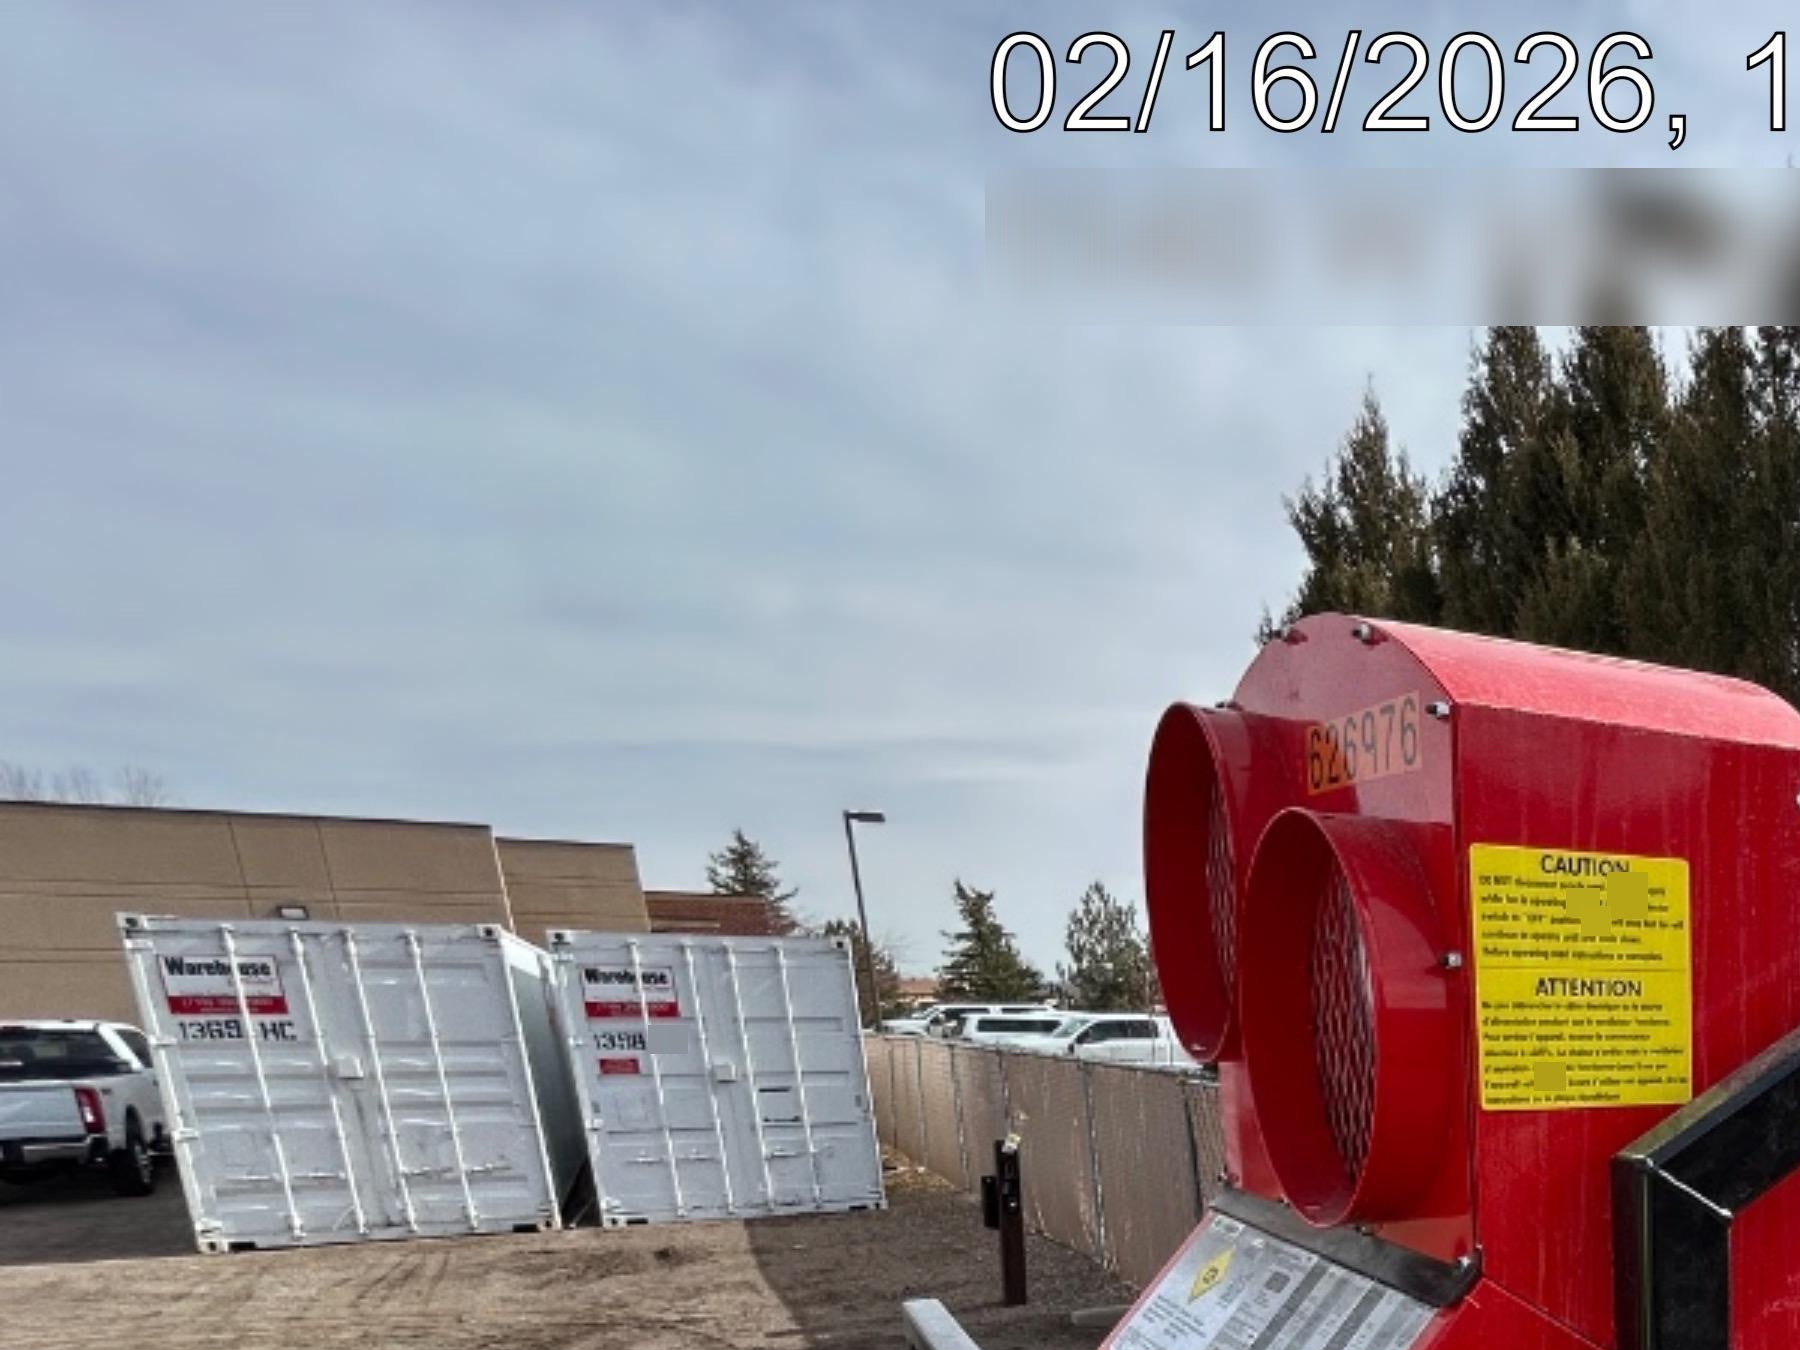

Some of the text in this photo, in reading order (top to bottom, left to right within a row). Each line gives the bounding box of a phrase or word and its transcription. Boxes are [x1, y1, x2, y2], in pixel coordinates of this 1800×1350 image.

[1309, 696, 1418, 789] 626976
[1541, 855, 1630, 877] CAUTION
[164, 956, 271, 977] Warehuse
[584, 968, 669, 985] Warehuse
[1536, 977, 1642, 997] ATTENTION
[259, 1020, 298, 1041] HC
